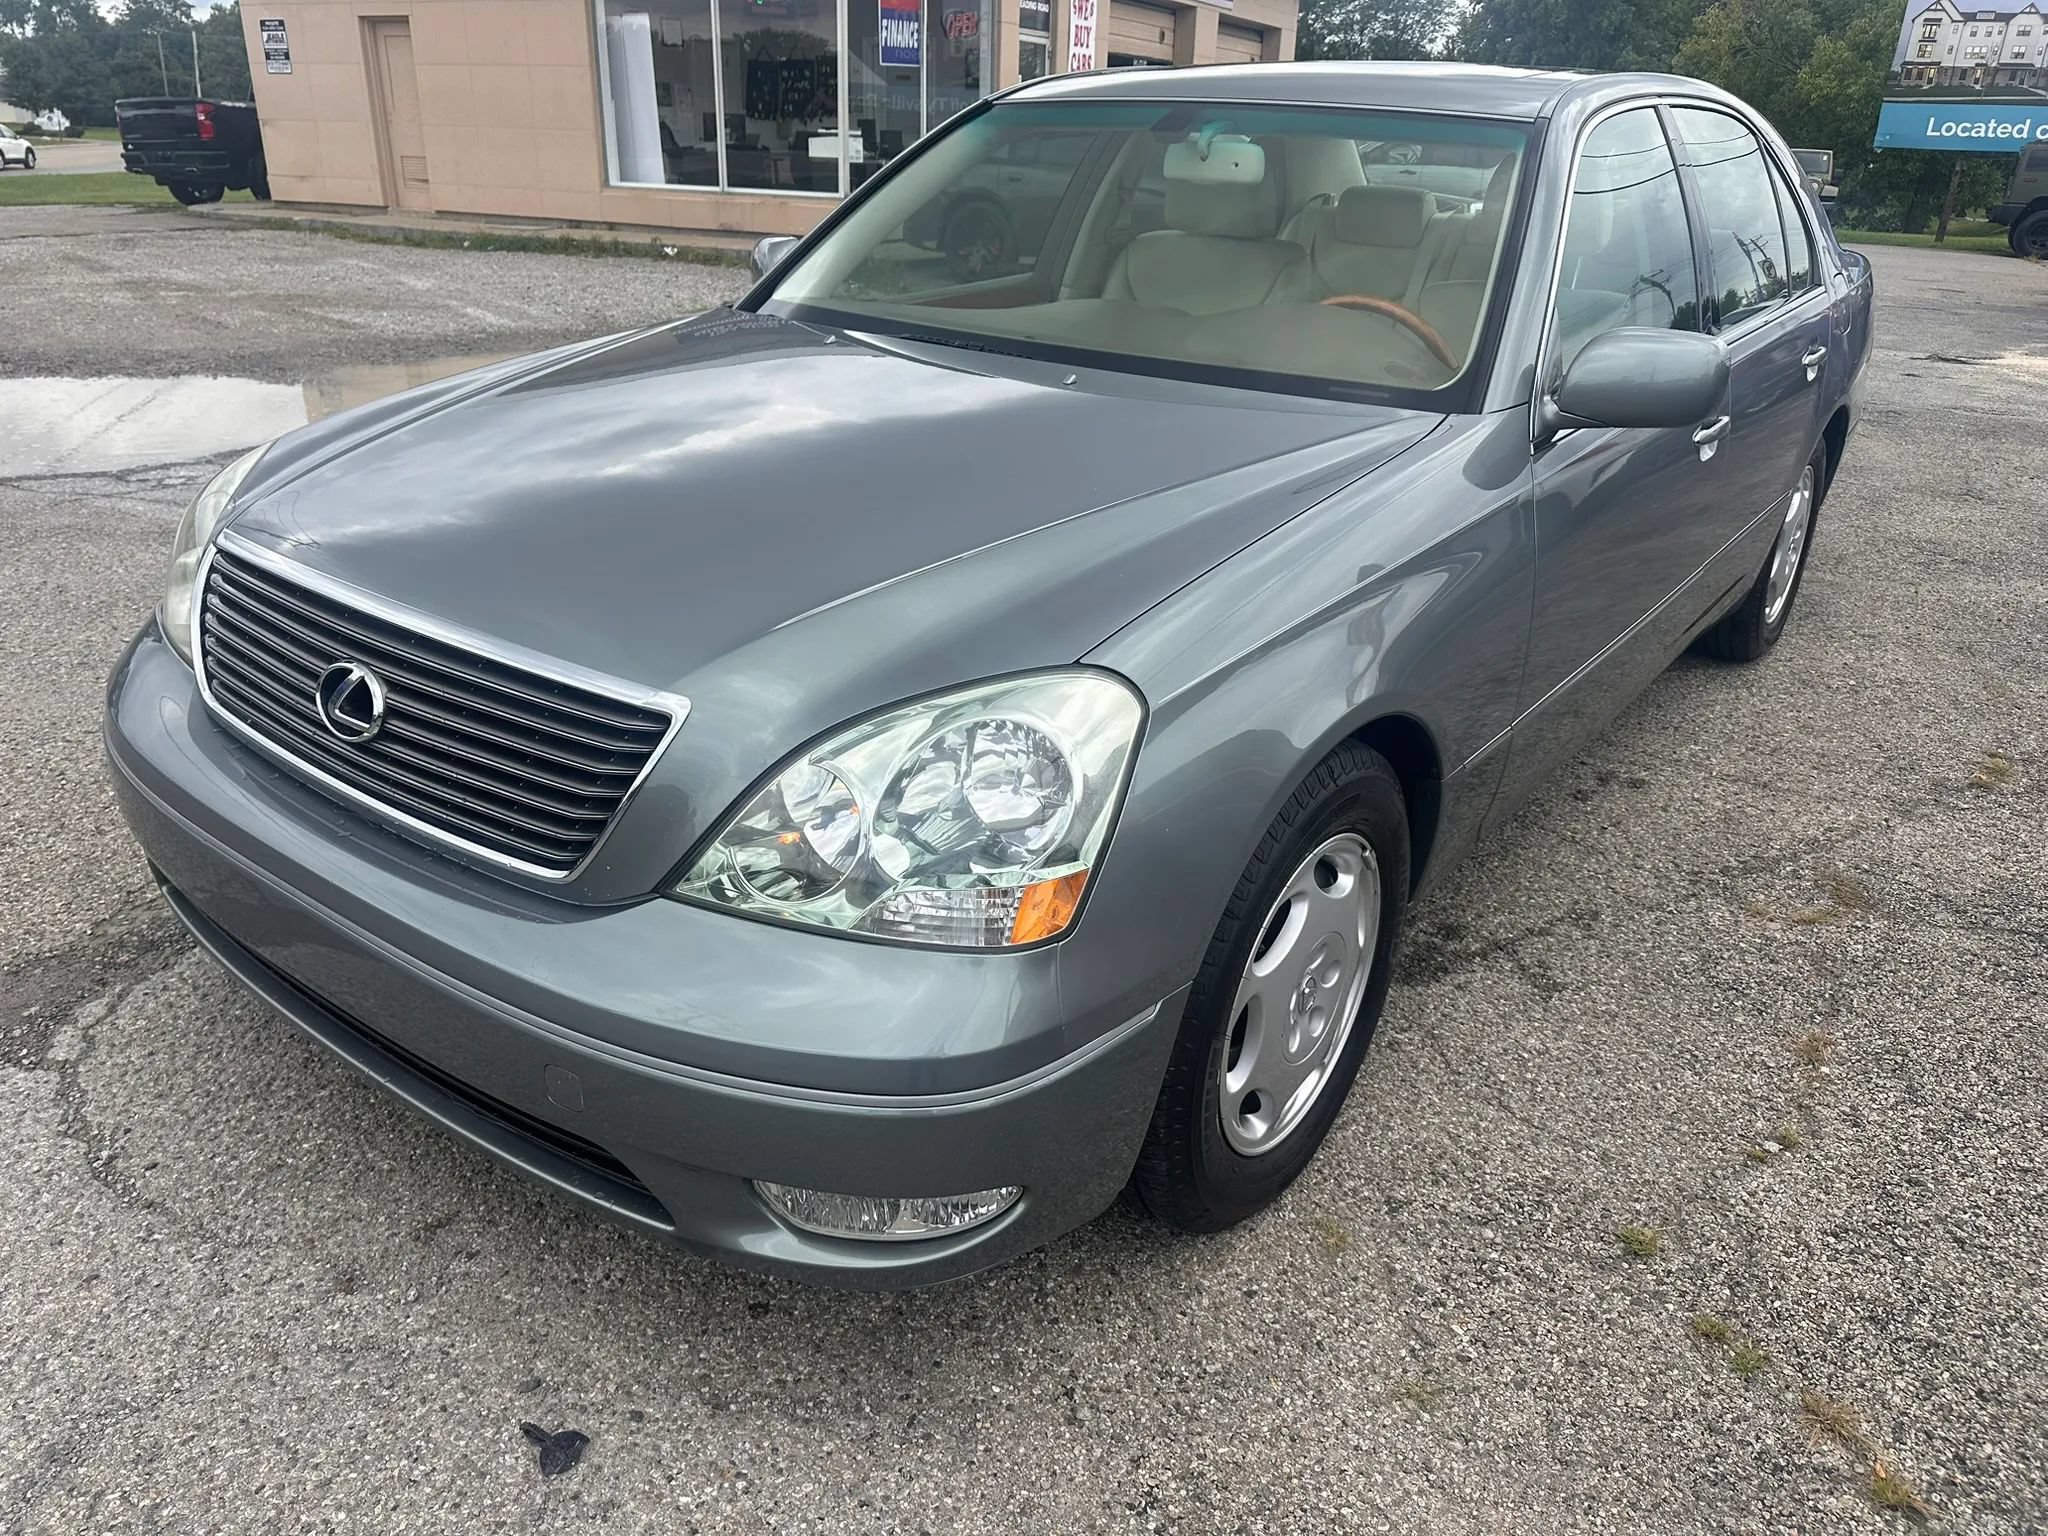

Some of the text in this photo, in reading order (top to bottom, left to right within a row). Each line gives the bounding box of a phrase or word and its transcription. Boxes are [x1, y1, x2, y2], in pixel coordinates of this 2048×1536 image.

[881, 18, 919, 49] FINANCE
[945, 10, 978, 39] OPEN
[1073, 25, 1092, 49] BUY
[1071, 52, 1092, 72] CARS
[1926, 117, 2031, 139] Located
